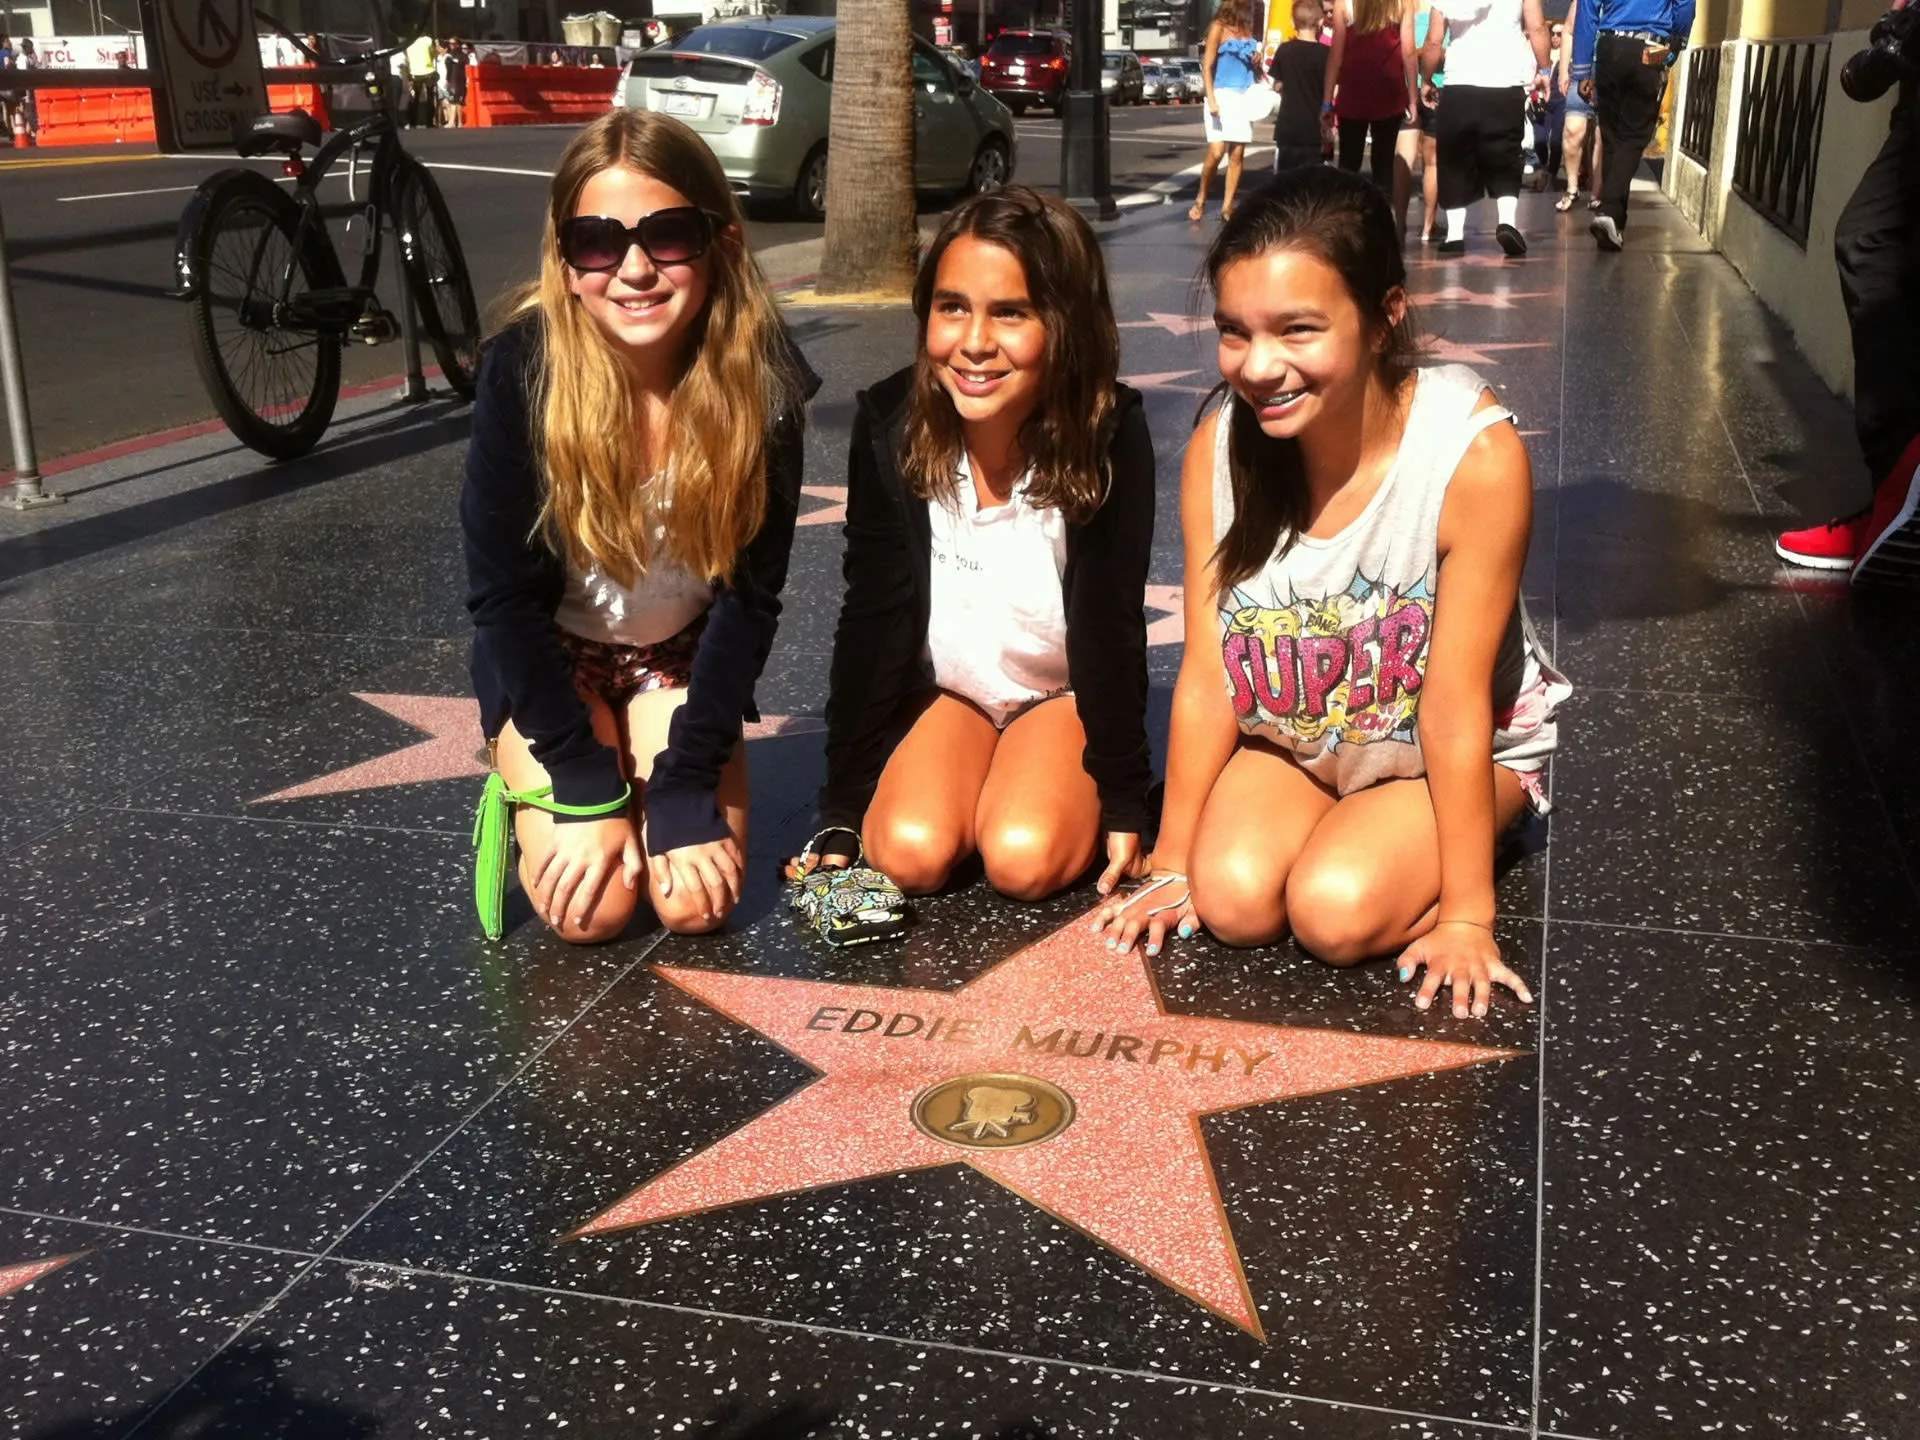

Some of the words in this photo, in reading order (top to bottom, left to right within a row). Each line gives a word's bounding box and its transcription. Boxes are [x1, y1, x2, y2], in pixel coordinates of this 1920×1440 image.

[44, 49, 76, 63] TCL
[190, 80, 222, 103] USE
[1223, 604, 1428, 716] SUPER
[805, 1005, 983, 1045] EDDIE
[1009, 1024, 1274, 1077] MURPHY
